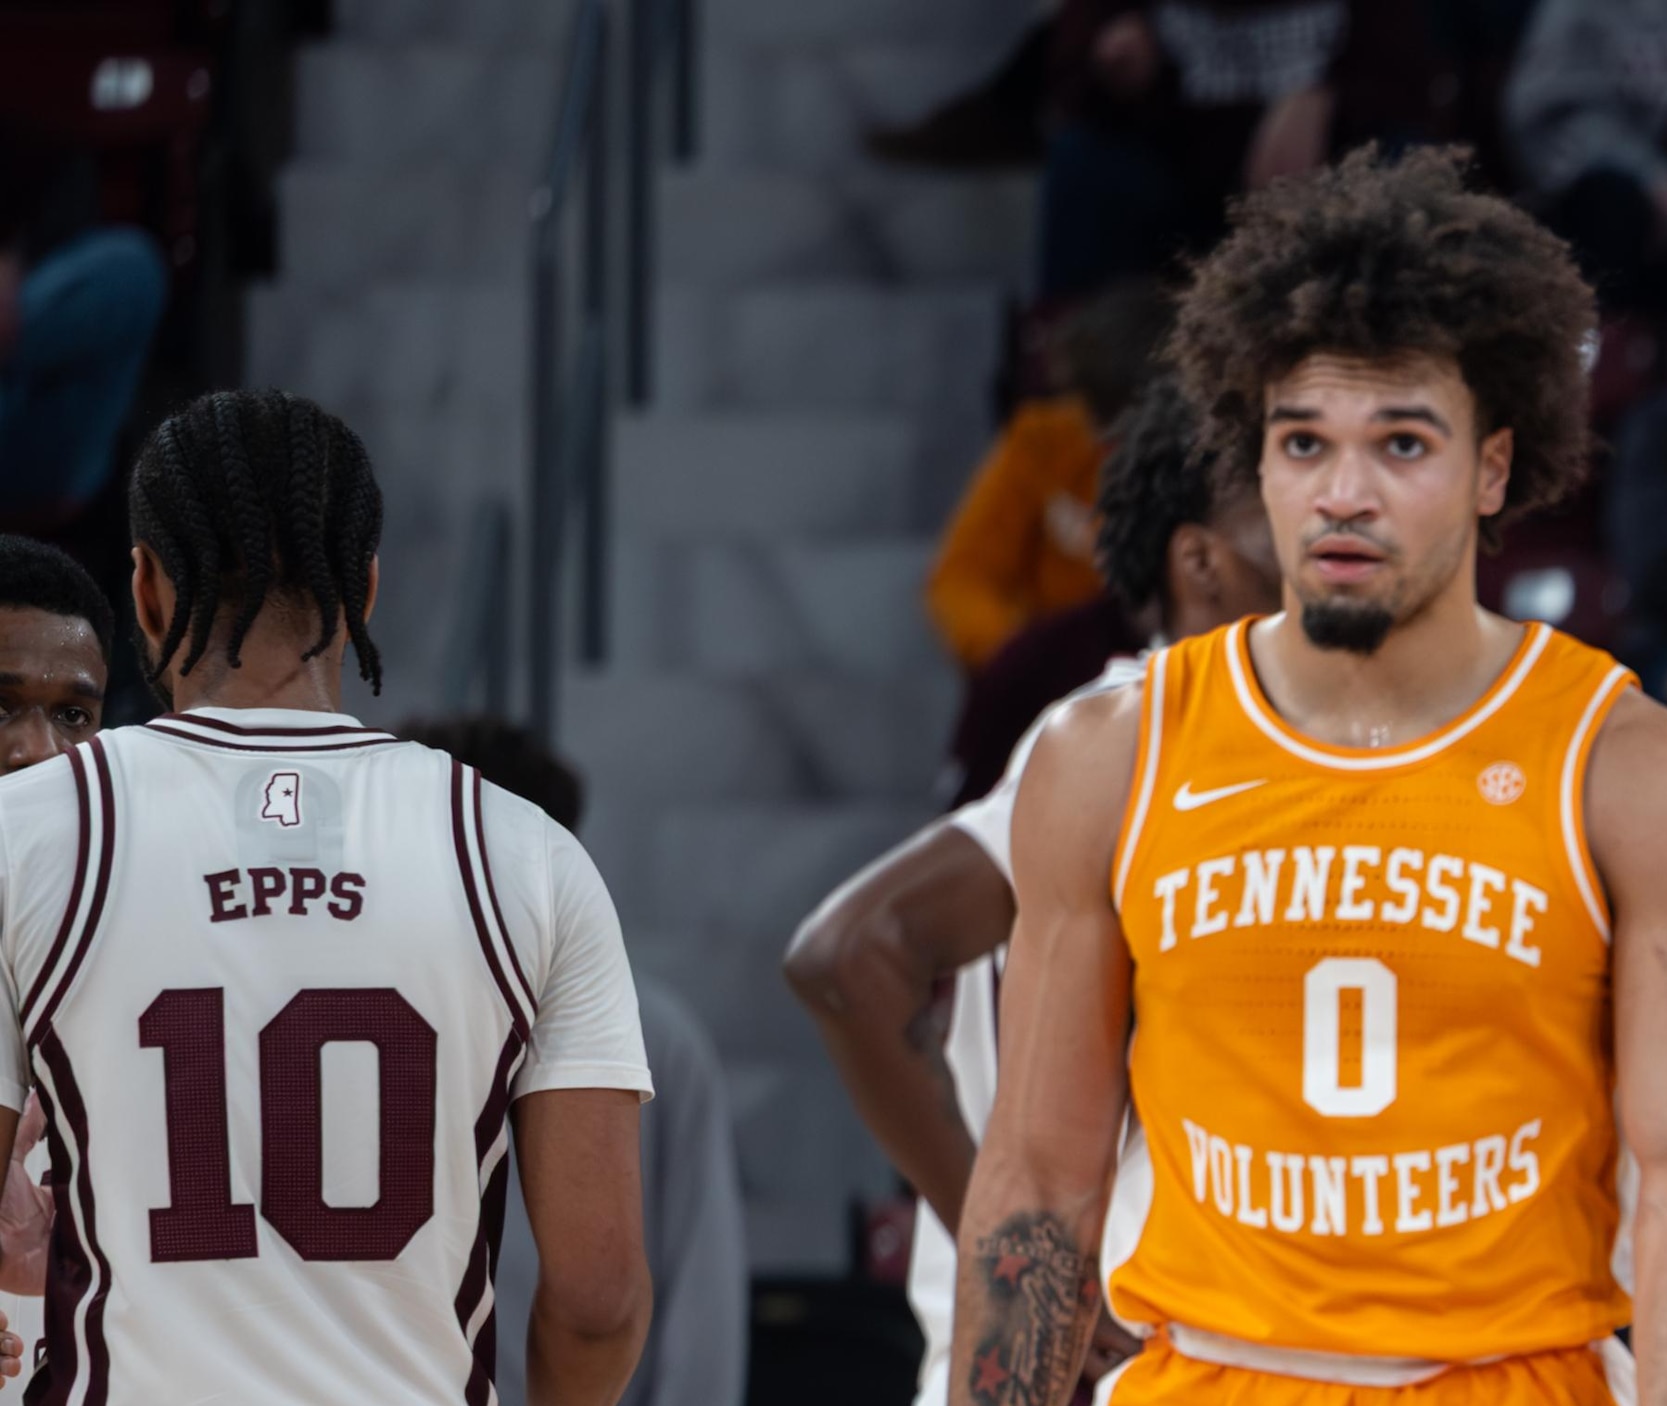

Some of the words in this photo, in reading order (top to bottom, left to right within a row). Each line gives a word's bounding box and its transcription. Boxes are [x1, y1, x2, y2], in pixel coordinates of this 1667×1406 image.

[203, 867, 366, 922] EPPS
[1154, 846, 1548, 967] TENNESSEE
[1302, 957, 1398, 1118] 0
[137, 986, 438, 1263] 10
[1183, 1118, 1542, 1237] VOLUNTEERS
